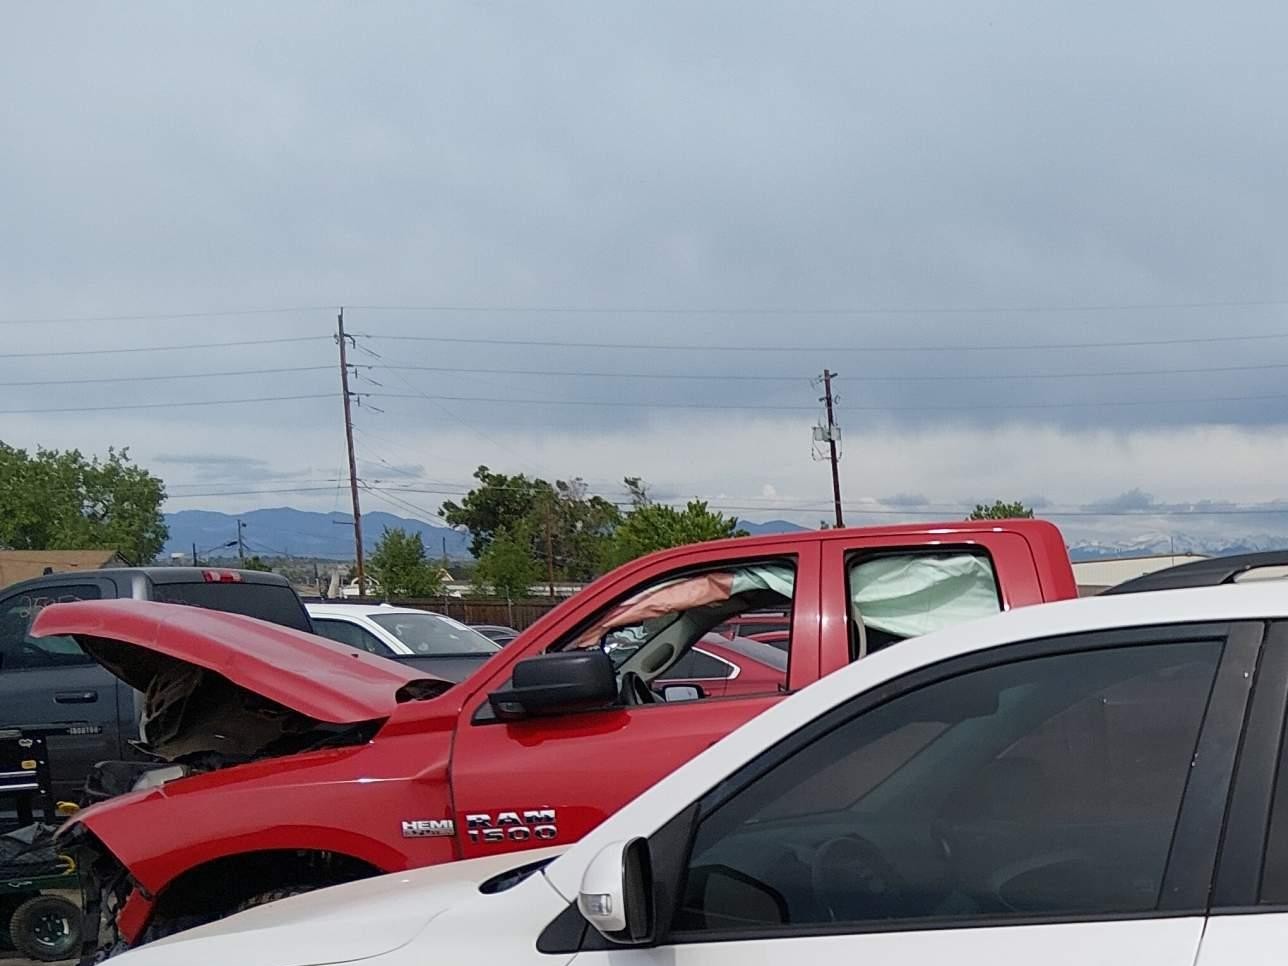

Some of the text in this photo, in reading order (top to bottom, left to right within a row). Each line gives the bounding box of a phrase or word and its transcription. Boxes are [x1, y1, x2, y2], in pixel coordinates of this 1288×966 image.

[402, 820, 454, 830] HEMI
[466, 809, 556, 828] RAM
[467, 825, 558, 842] 1500
